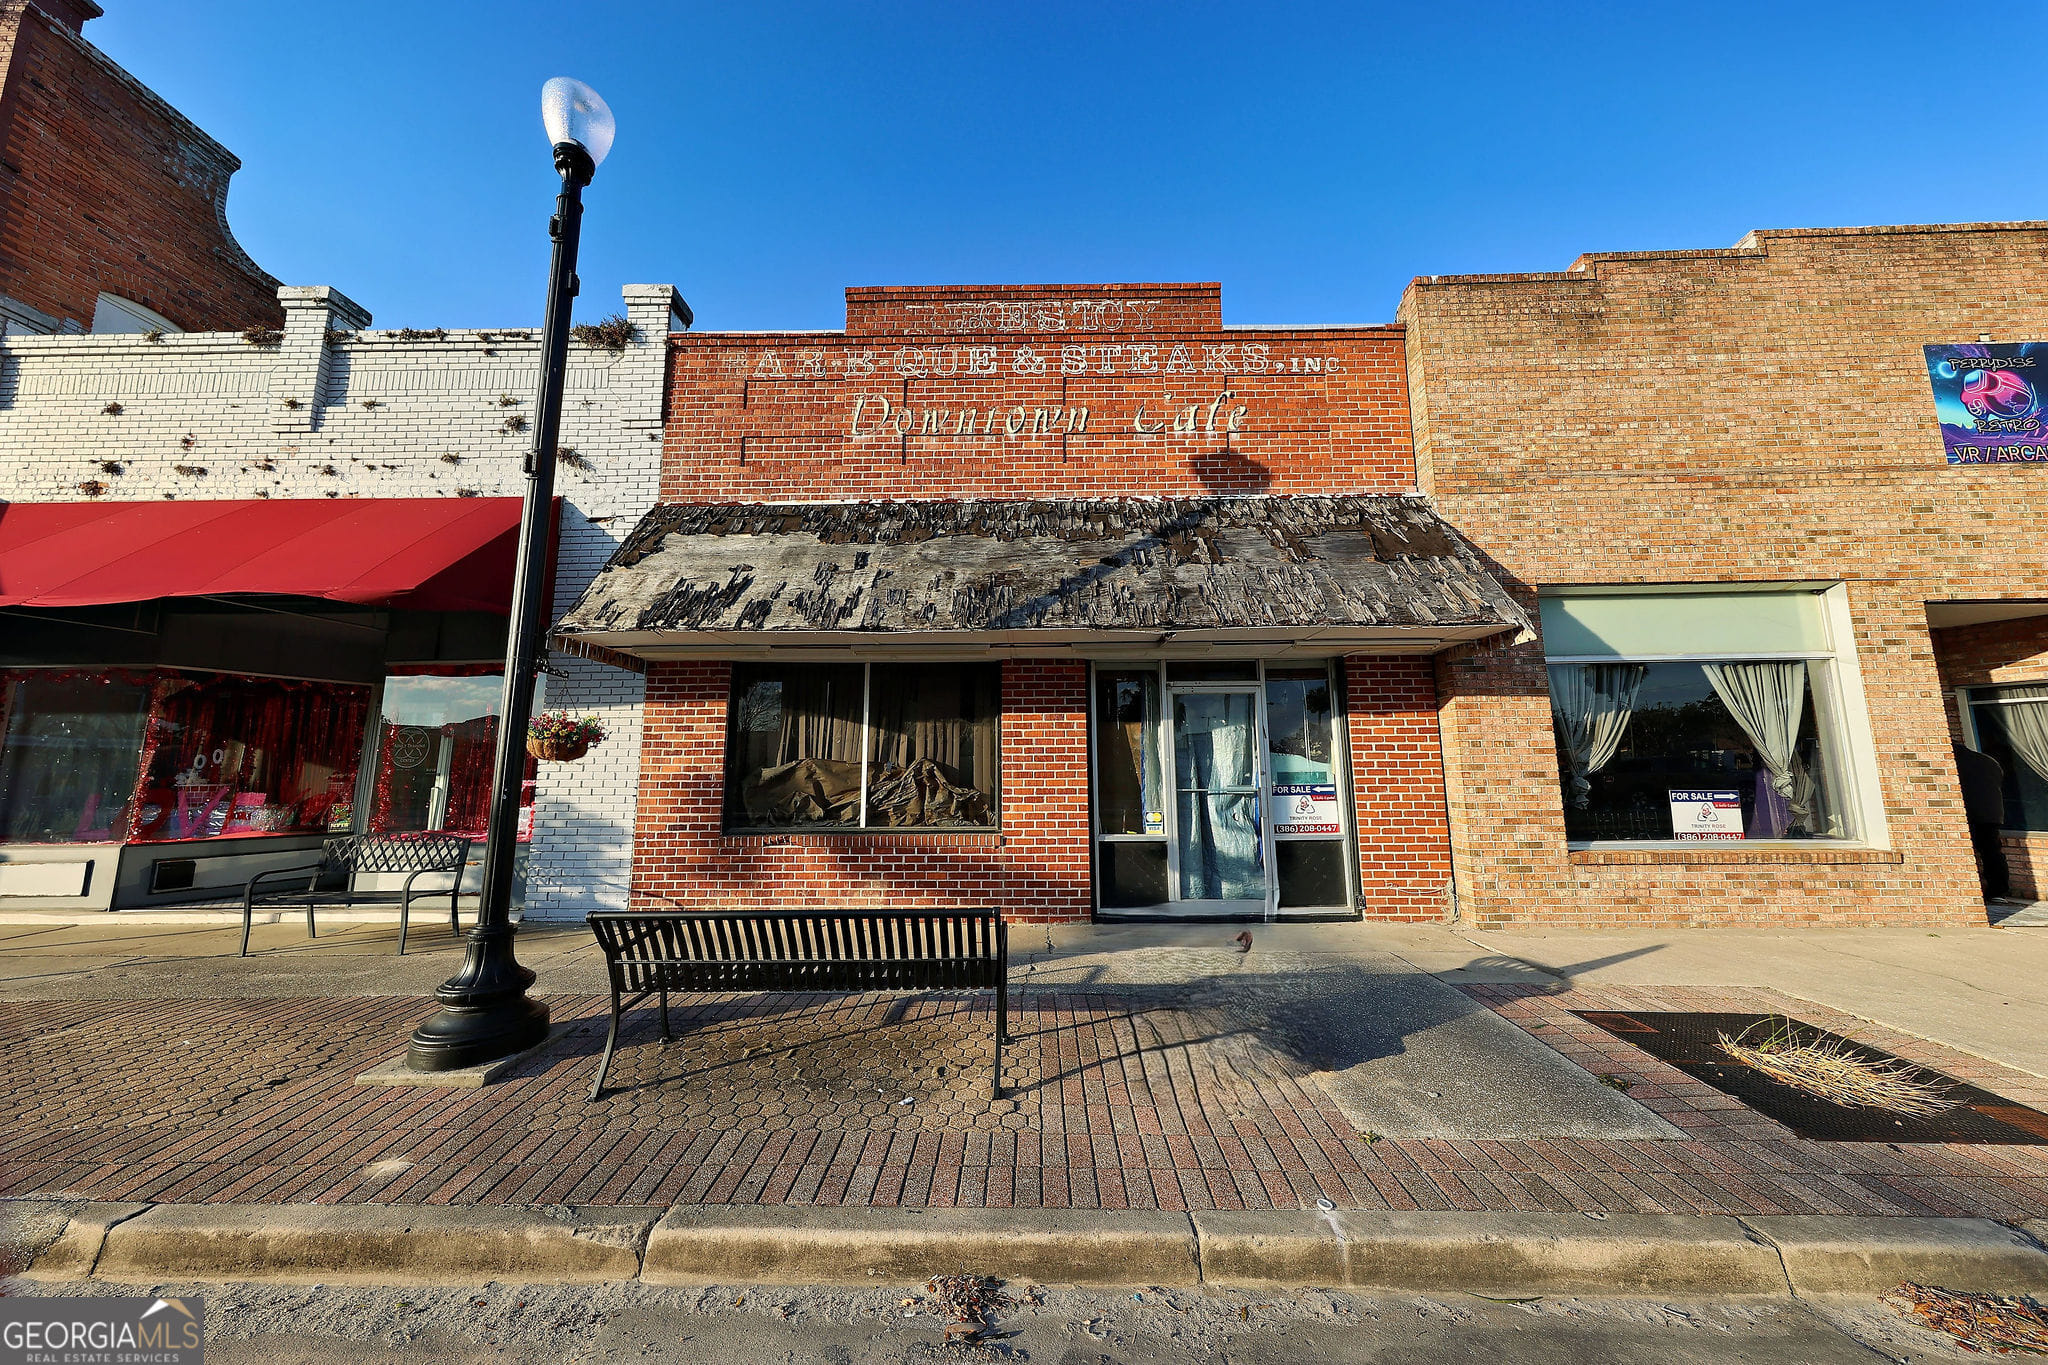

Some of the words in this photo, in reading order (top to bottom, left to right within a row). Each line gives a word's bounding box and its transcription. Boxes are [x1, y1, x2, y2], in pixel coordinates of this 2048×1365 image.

[1012, 344, 1047, 377] &
[1948, 356, 2037, 372] PERRYDISE
[1973, 419, 2040, 433] RETRO
[1953, 446, 1982, 462] VR
[1996, 445, 2048, 462] ARCA
[1272, 786, 1289, 794] FOR
[1290, 785, 1312, 793] SALE
[1671, 792, 1689, 800] FOR
[1690, 792, 1713, 800] SALE
[1276, 824, 1298, 833] (386)
[1299, 824, 1337, 832] 208-0447
[1677, 832, 1701, 840] (386)
